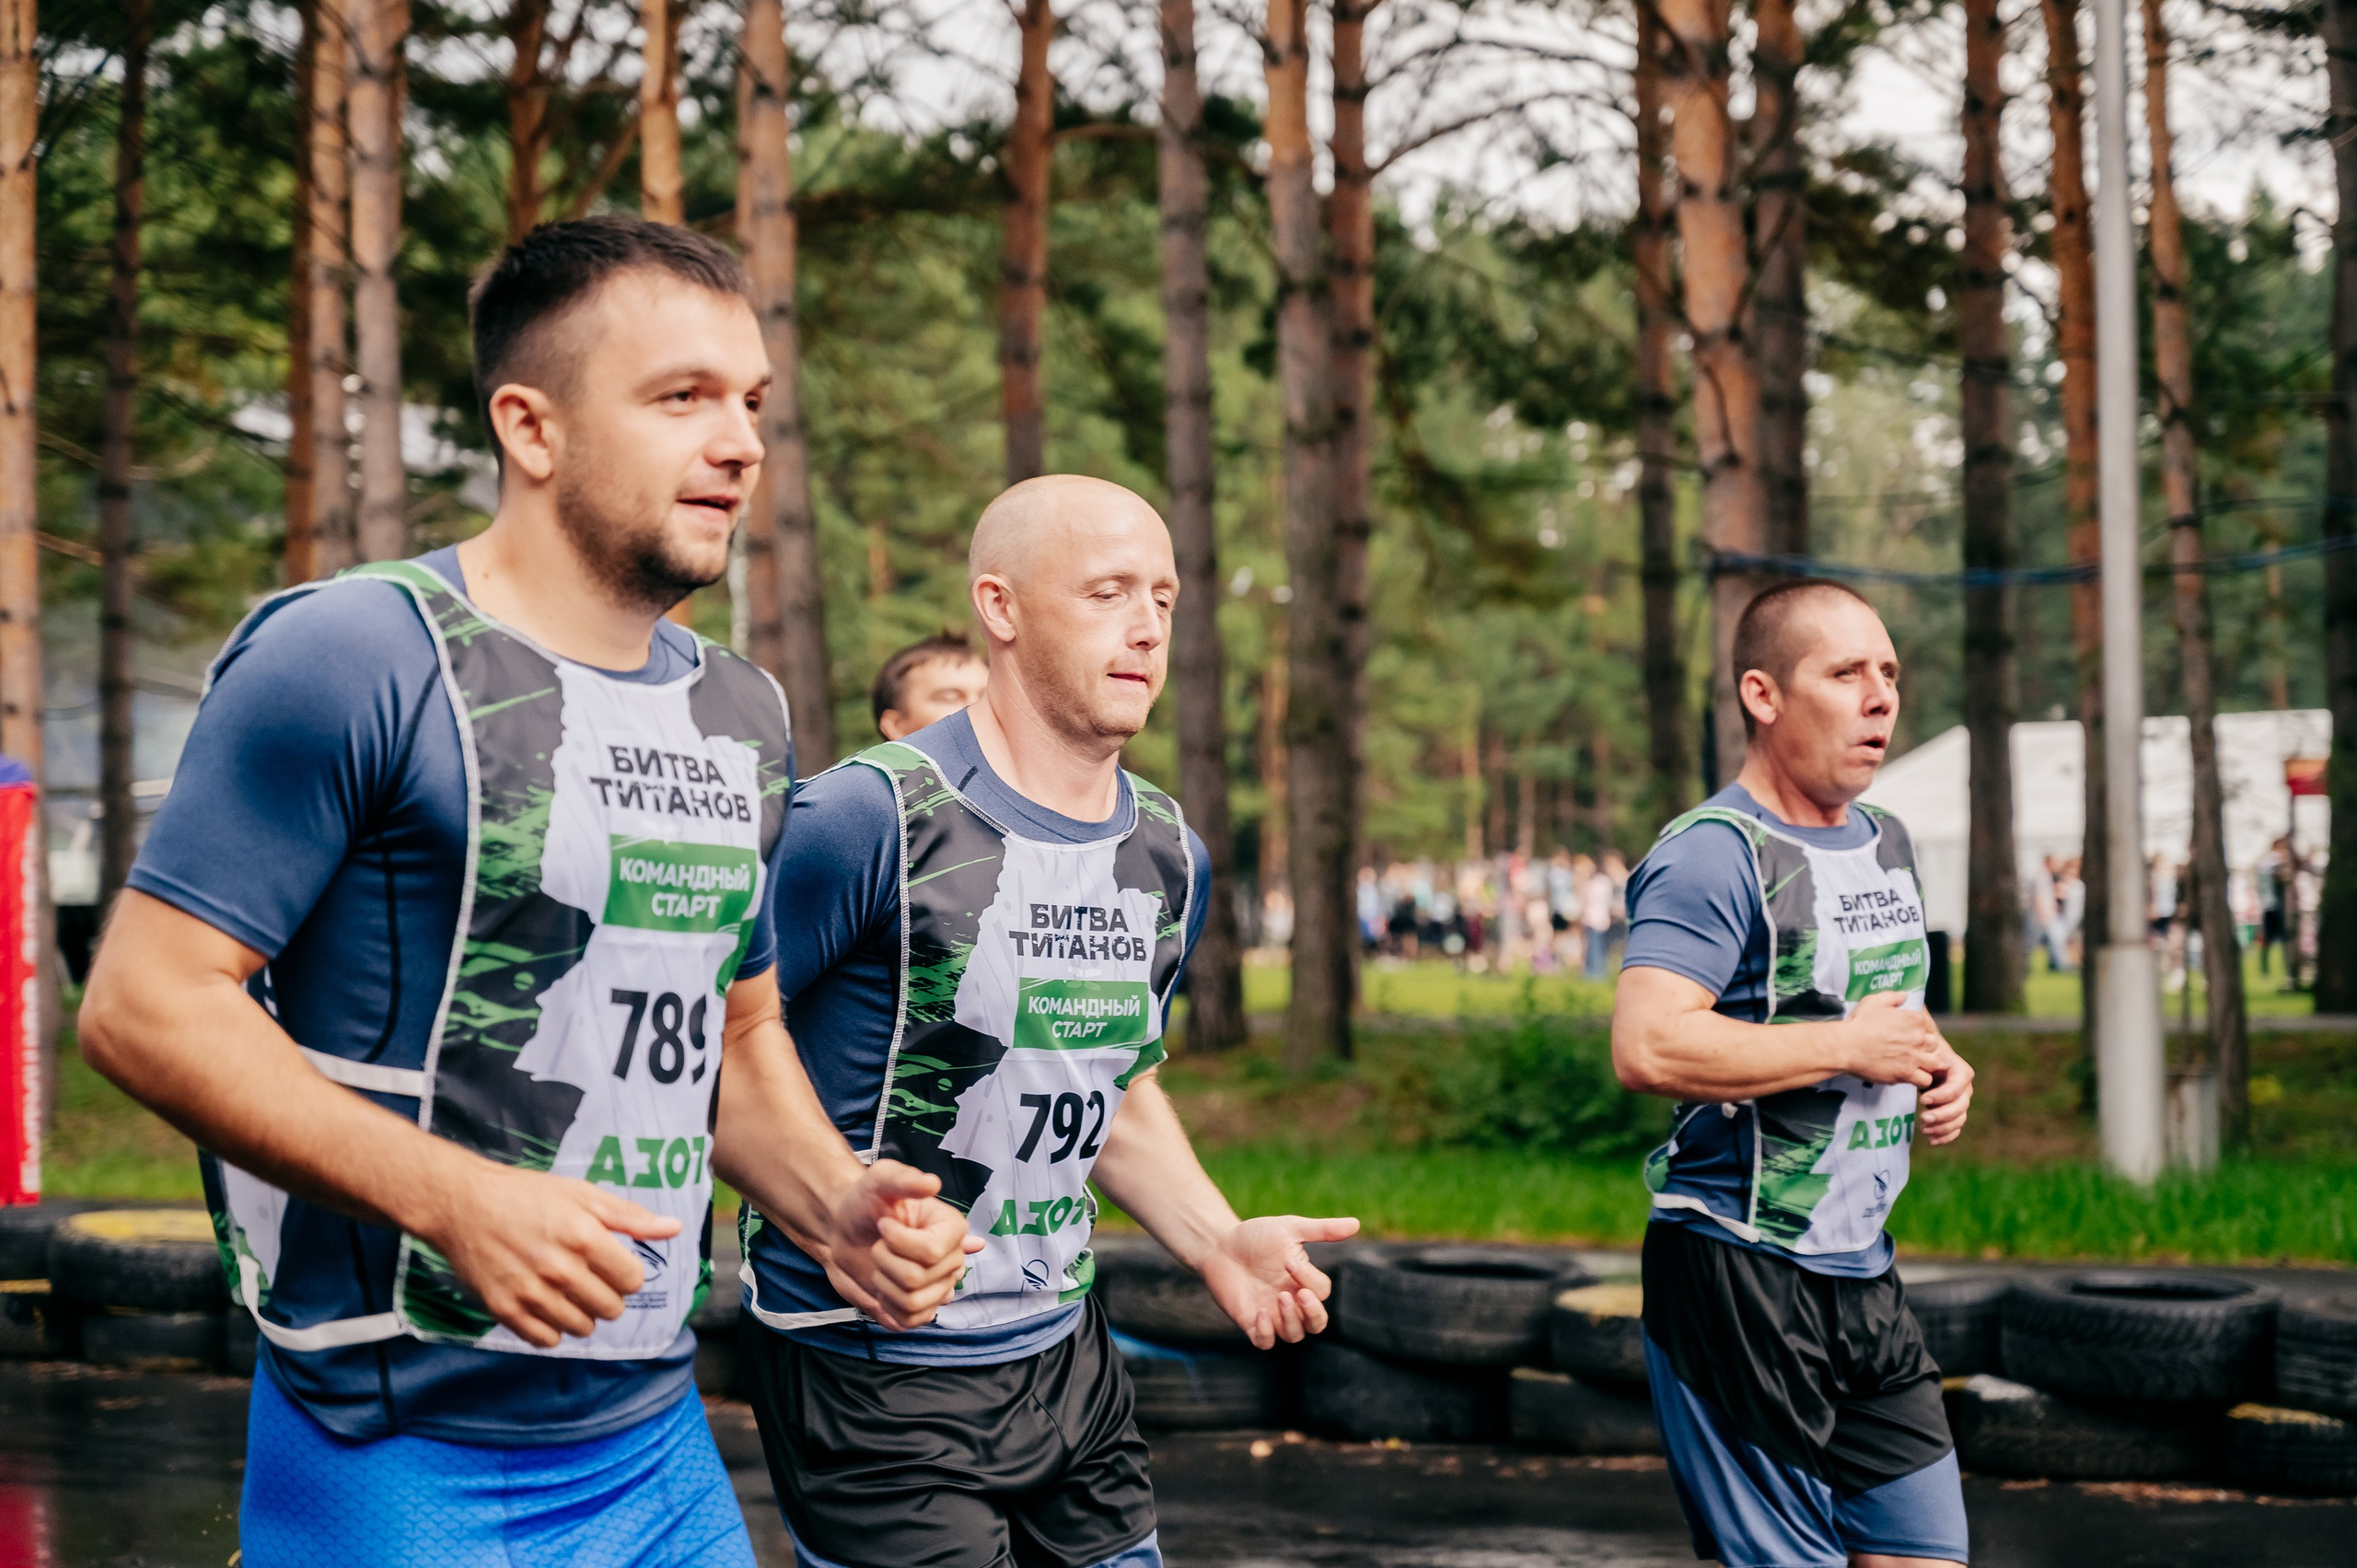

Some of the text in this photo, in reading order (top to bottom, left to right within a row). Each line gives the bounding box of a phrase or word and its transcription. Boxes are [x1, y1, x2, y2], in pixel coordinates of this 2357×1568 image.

[608, 745, 727, 787] БИТВА
[589, 776, 751, 822] ТИТАНОВ
[619, 857, 751, 892] КОМАНДНЫЙ
[650, 891, 722, 919] СТАРТ
[1839, 889, 1903, 912] БИТВА
[1029, 903, 1130, 933] БИТВА
[1833, 906, 1921, 935] ТИТАНОВ
[1008, 931, 1147, 962] ТИТАНОВ
[1853, 947, 1922, 976] КОМАНДНЫЙ
[1869, 971, 1905, 991] СТАРТ
[1028, 994, 1141, 1019] КОМАНДНЫЙ
[1051, 1020, 1108, 1039] СТАРТ
[1015, 1090, 1106, 1165] 792
[1847, 1112, 1916, 1151] АЗОТ
